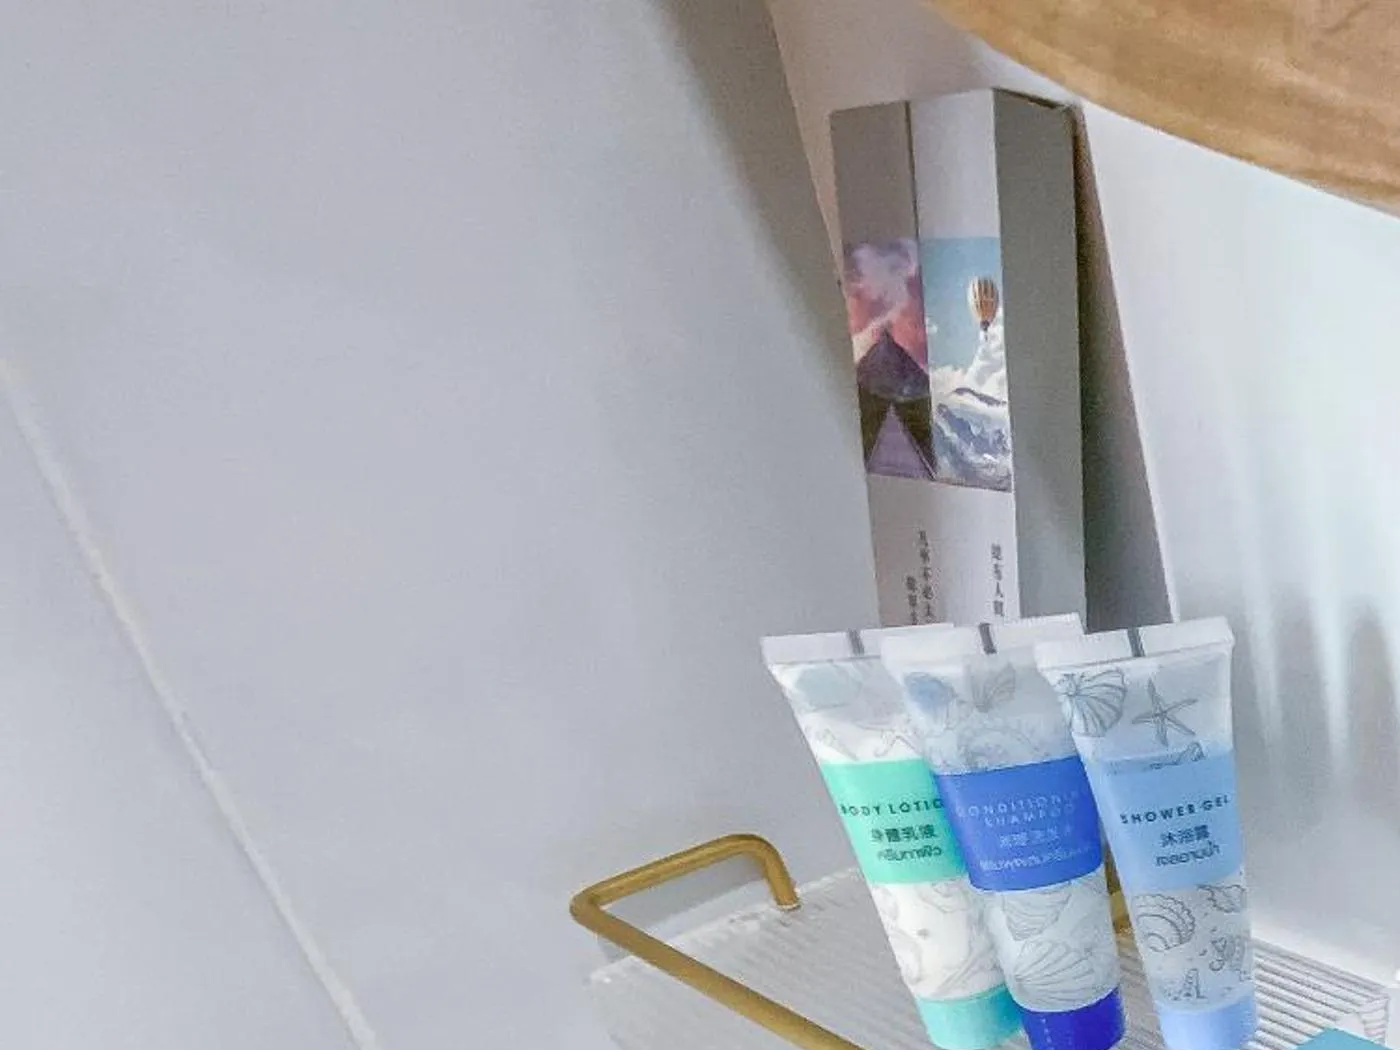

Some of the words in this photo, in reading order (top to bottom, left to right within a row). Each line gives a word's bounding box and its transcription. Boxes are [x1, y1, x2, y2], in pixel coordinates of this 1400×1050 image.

[888, 799, 944, 814] LOTIO
[1120, 804, 1196, 824] SHOWER
[1202, 795, 1228, 811] GEL
